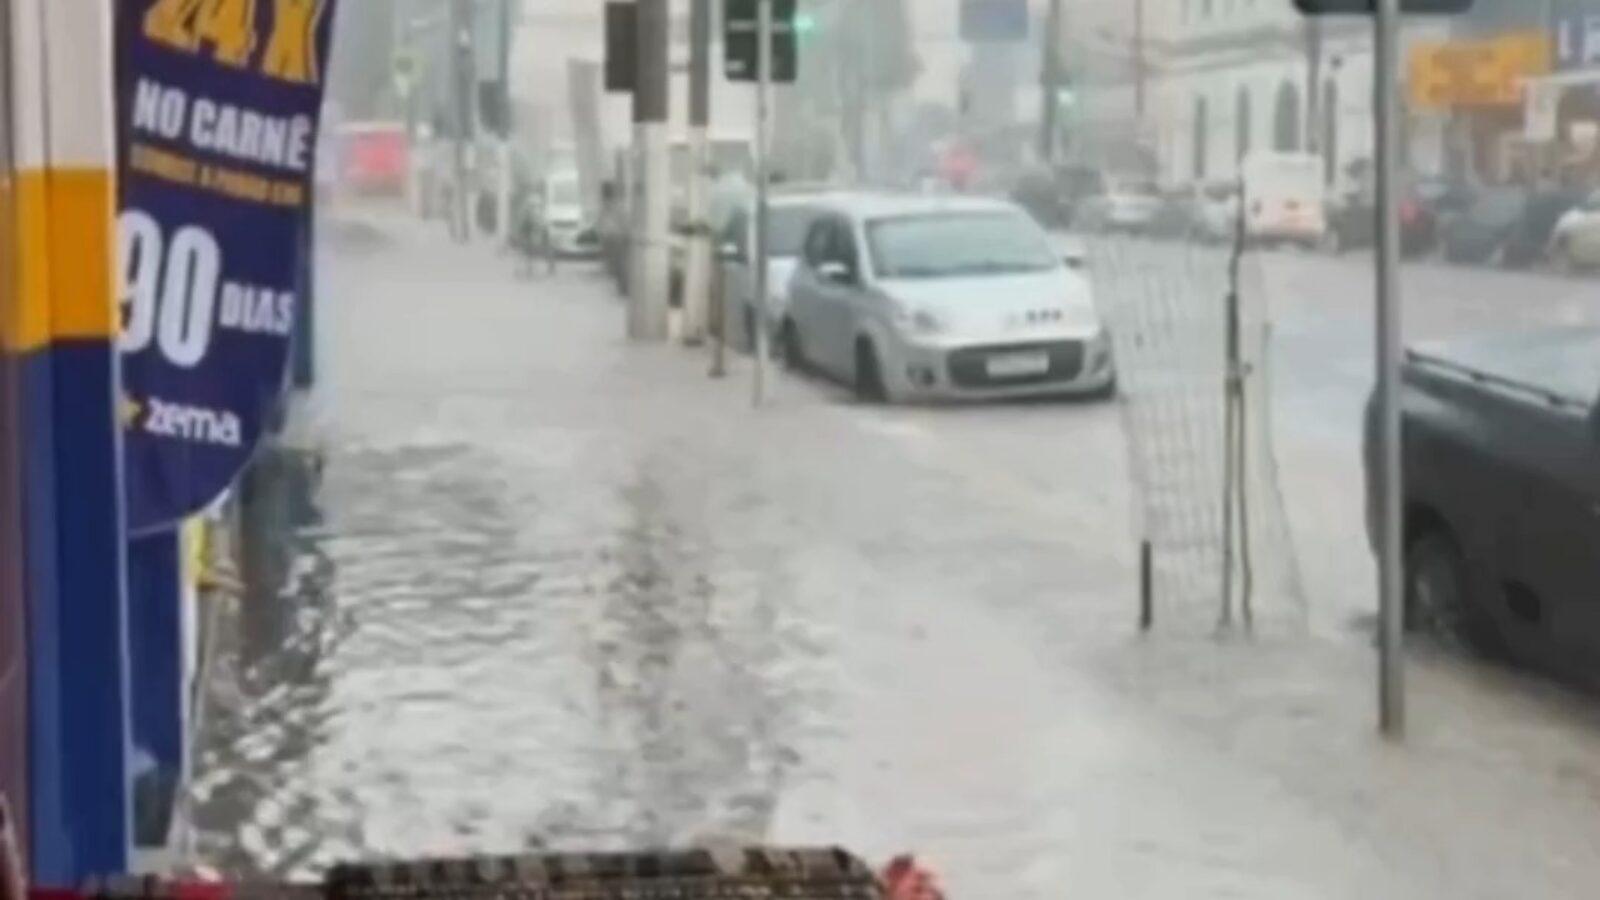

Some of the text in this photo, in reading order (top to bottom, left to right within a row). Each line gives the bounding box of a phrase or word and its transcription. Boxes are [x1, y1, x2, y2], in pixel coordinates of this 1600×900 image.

[133, 77, 311, 171] NO CARNÊ
[117, 209, 294, 369] 90 DIAS
[145, 396, 242, 446] zema
